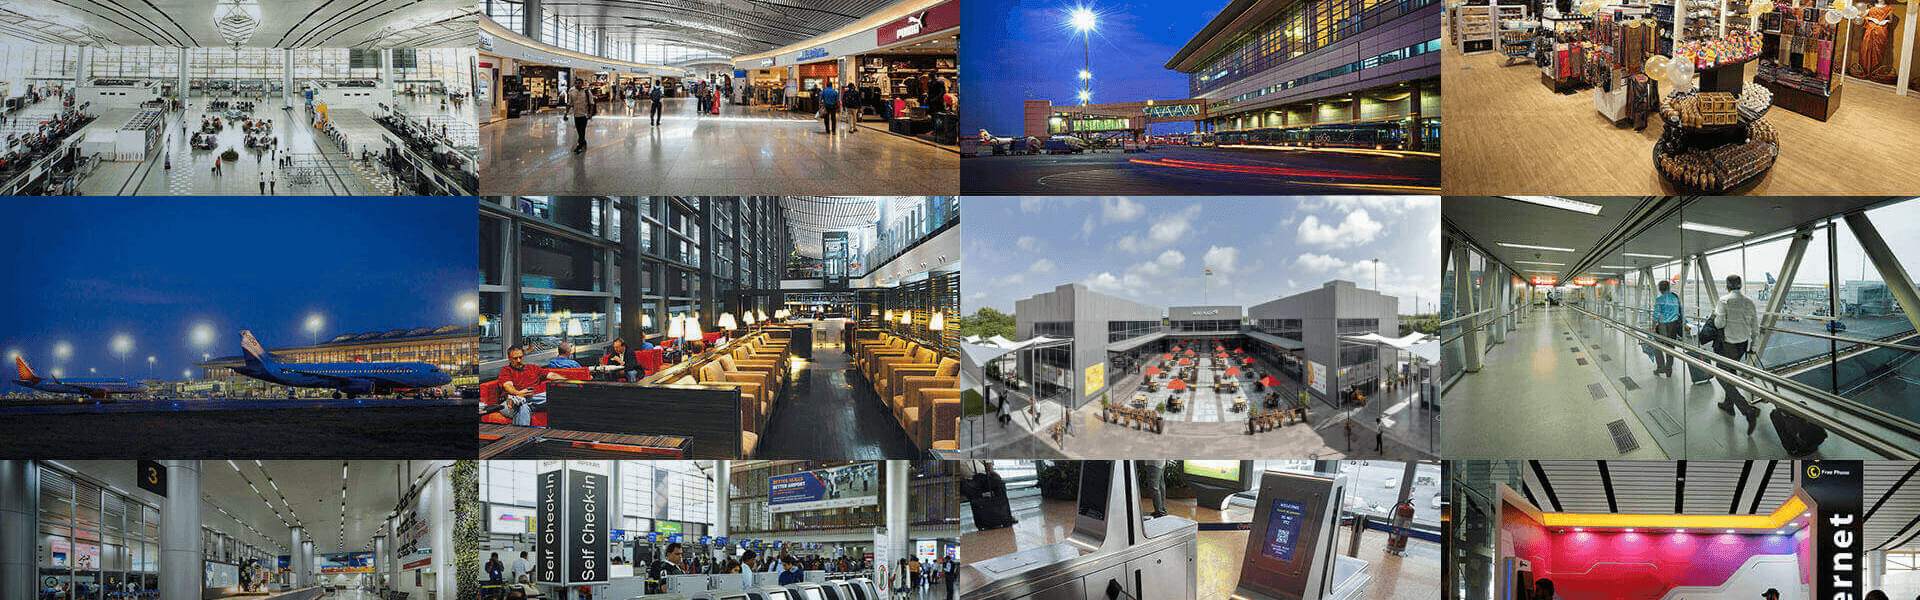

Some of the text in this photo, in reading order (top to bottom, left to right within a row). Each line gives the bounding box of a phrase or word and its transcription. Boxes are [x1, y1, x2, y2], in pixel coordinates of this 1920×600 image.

[896, 23, 919, 39] PUMA
[148, 466, 158, 485] 3
[545, 474, 554, 544] Check-in
[582, 474, 595, 545] Check-in
[545, 549, 554, 581] Self
[582, 548, 595, 581] Self
